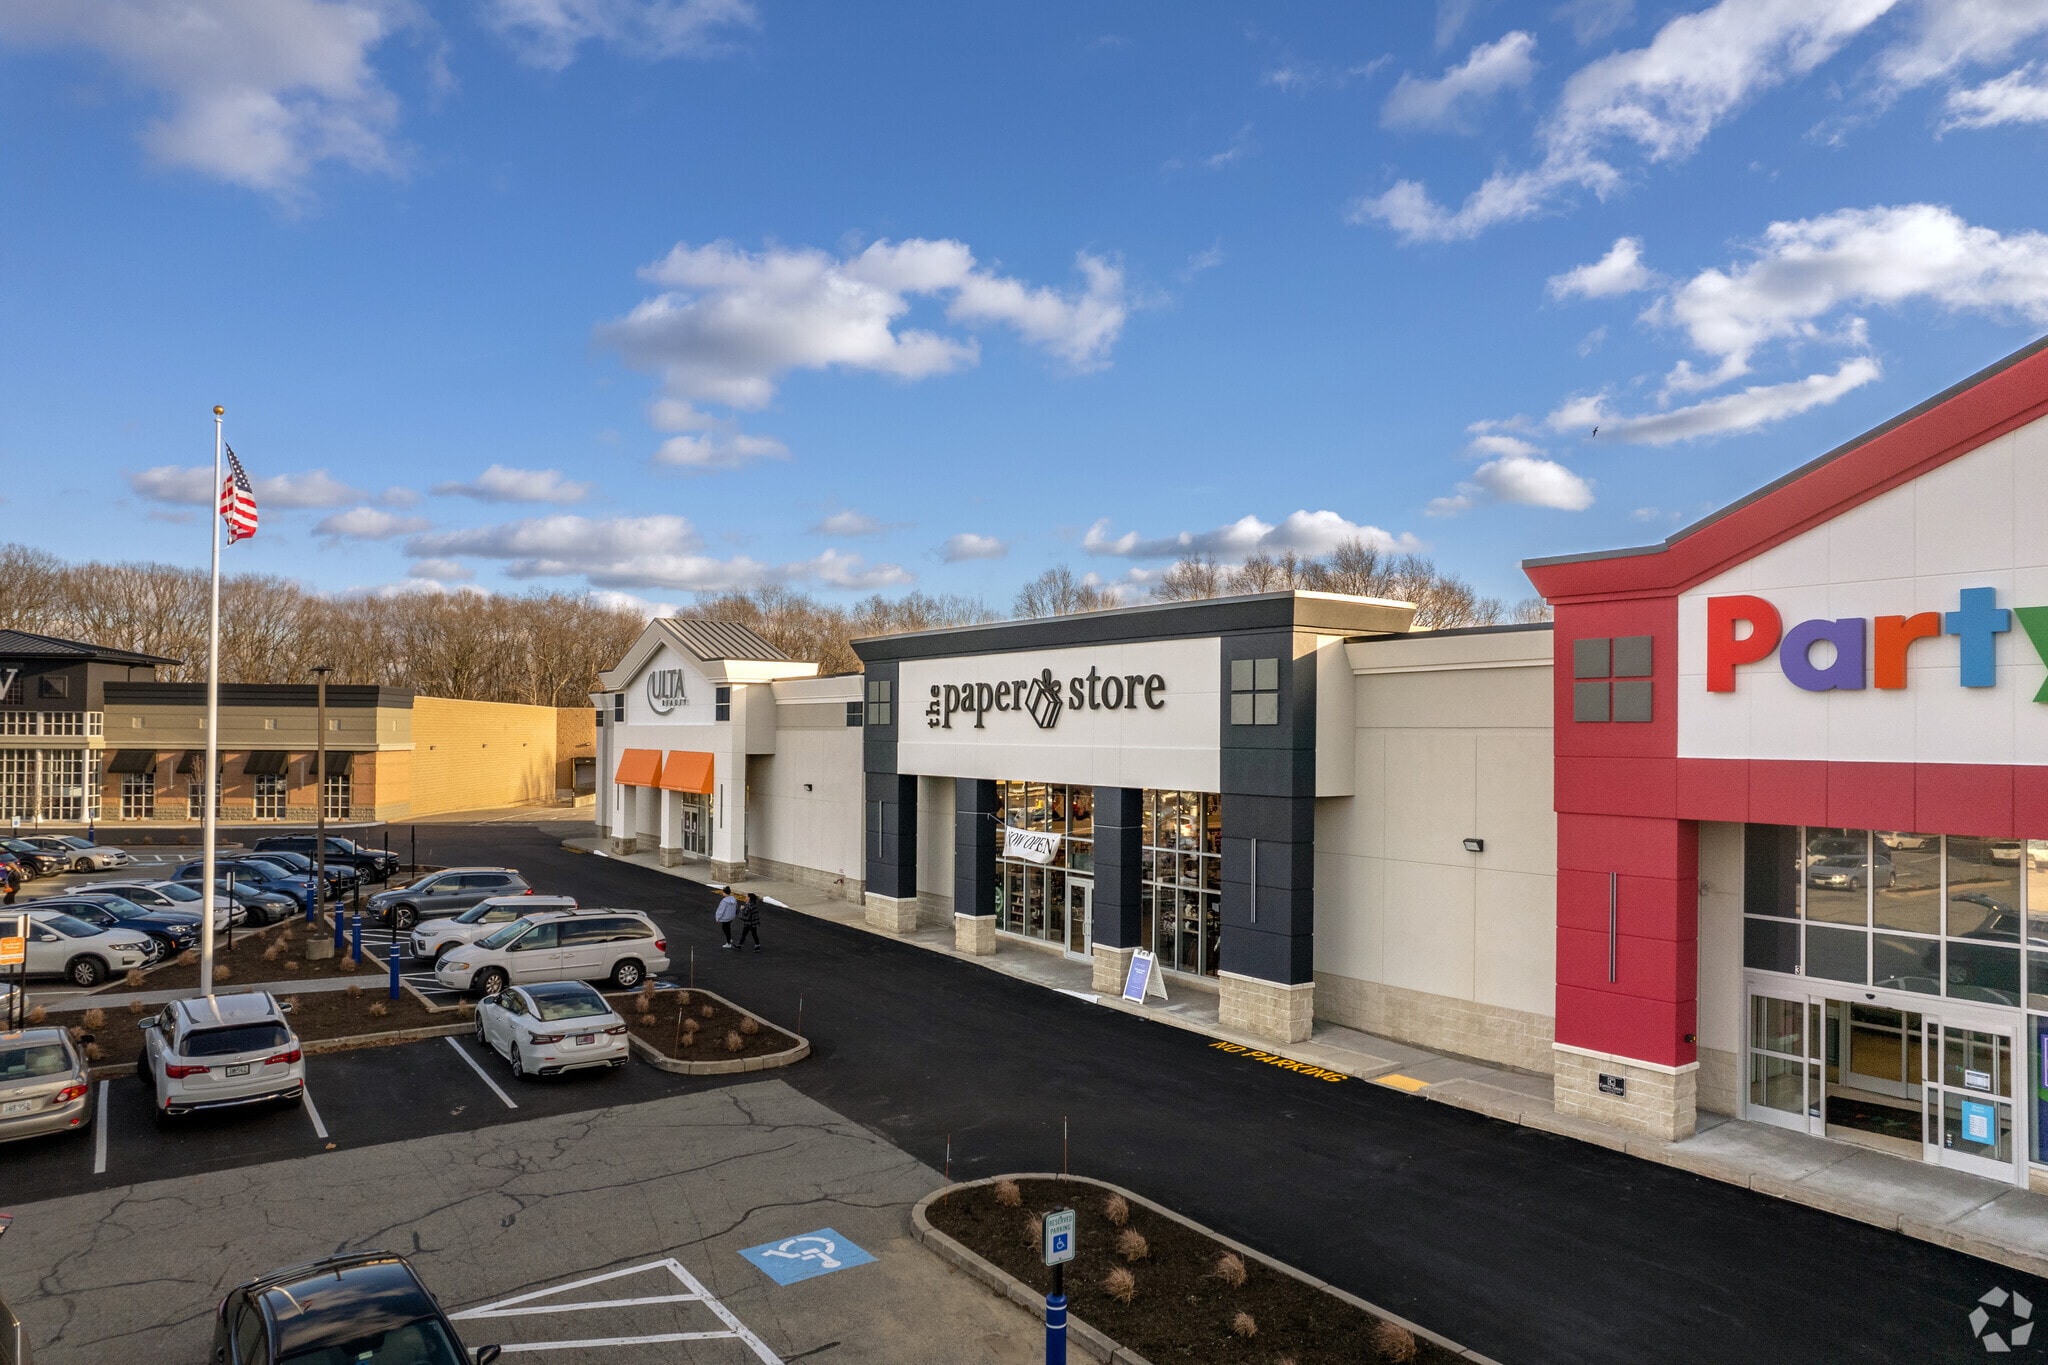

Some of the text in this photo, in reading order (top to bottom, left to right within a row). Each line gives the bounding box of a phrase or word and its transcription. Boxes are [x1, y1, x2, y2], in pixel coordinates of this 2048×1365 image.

[652, 668, 686, 699] ULTA
[926, 665, 1166, 729] the paper store
[1023, 836, 1055, 855] OPEN
[1208, 1041, 1348, 1082] NO PARKING
[1048, 1214, 1073, 1227] RESERVED
[1050, 1224, 1071, 1235] PARKING
